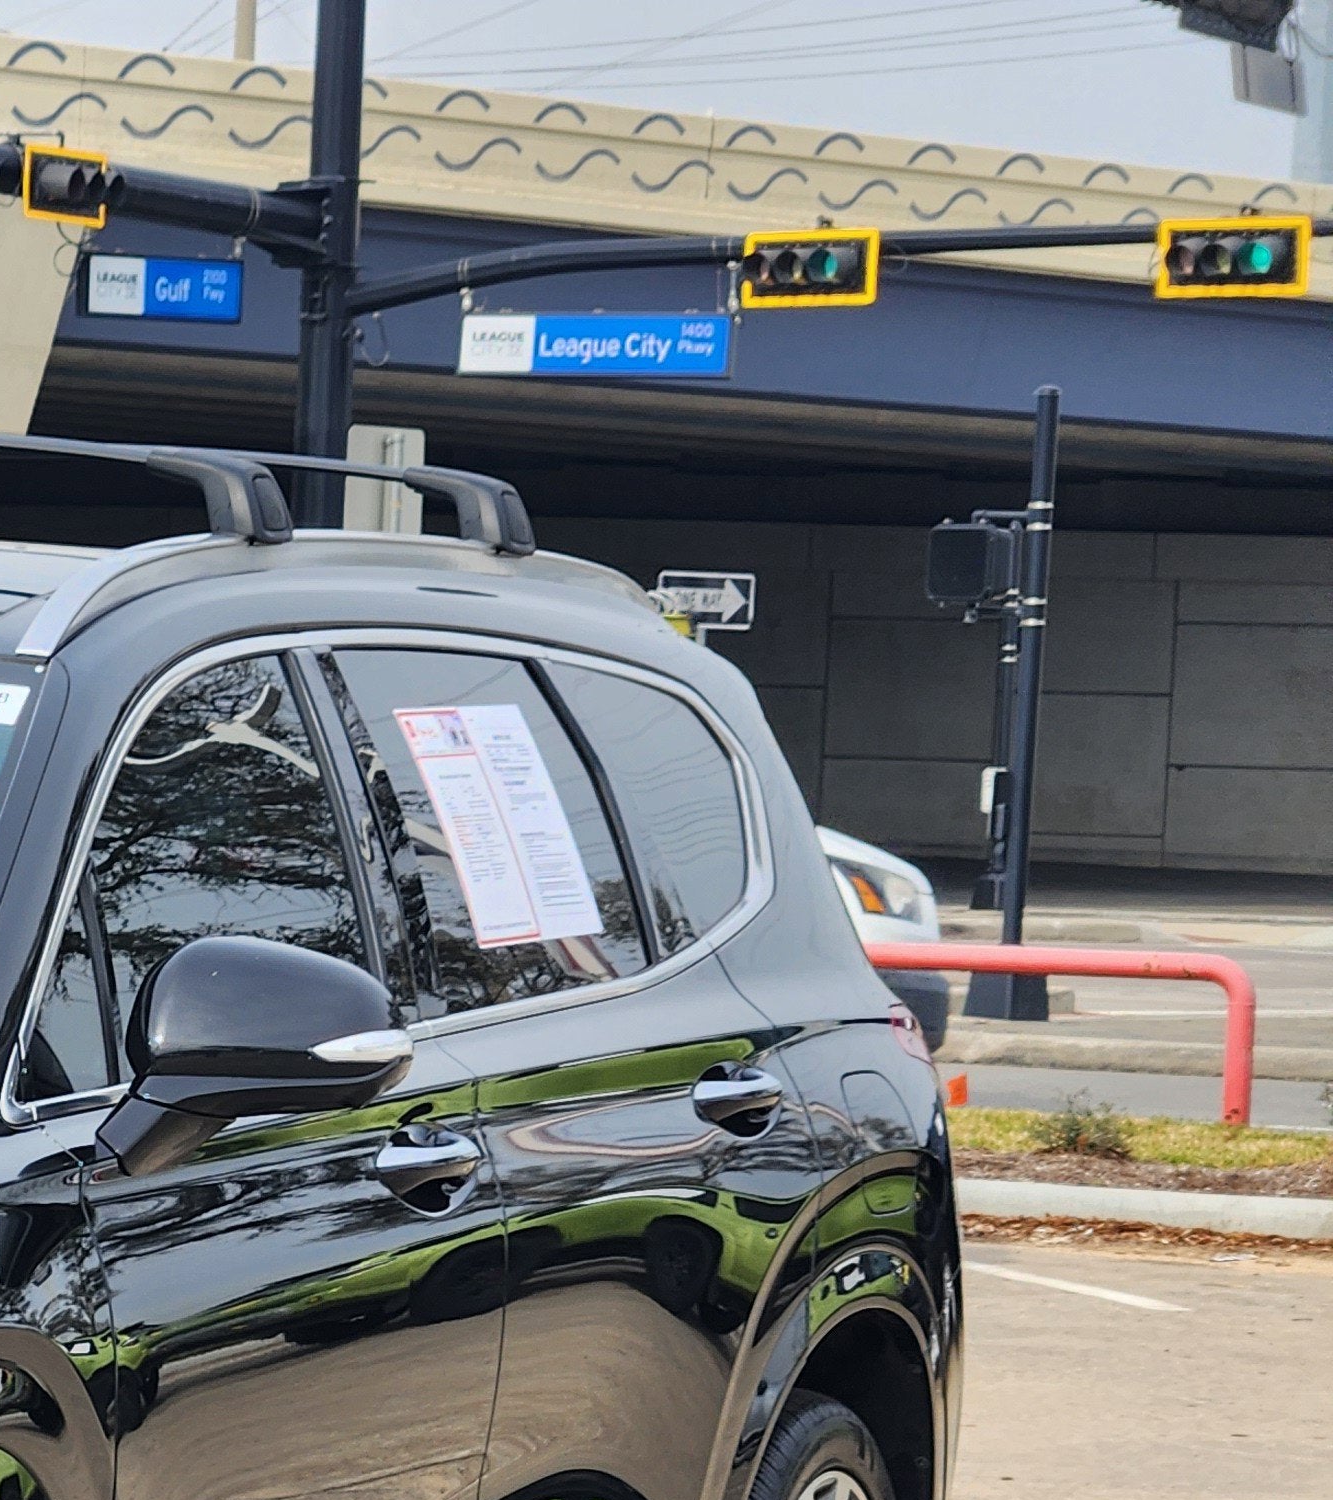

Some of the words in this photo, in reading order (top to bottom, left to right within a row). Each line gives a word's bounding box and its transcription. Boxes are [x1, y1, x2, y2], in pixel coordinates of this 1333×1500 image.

[96, 270, 139, 284] LEAGUE
[154, 276, 191, 303] Gulf
[472, 331, 526, 343] LEAGUE
[681, 321, 715, 338] 1400
[538, 332, 621, 364] League
[624, 332, 671, 364] City
